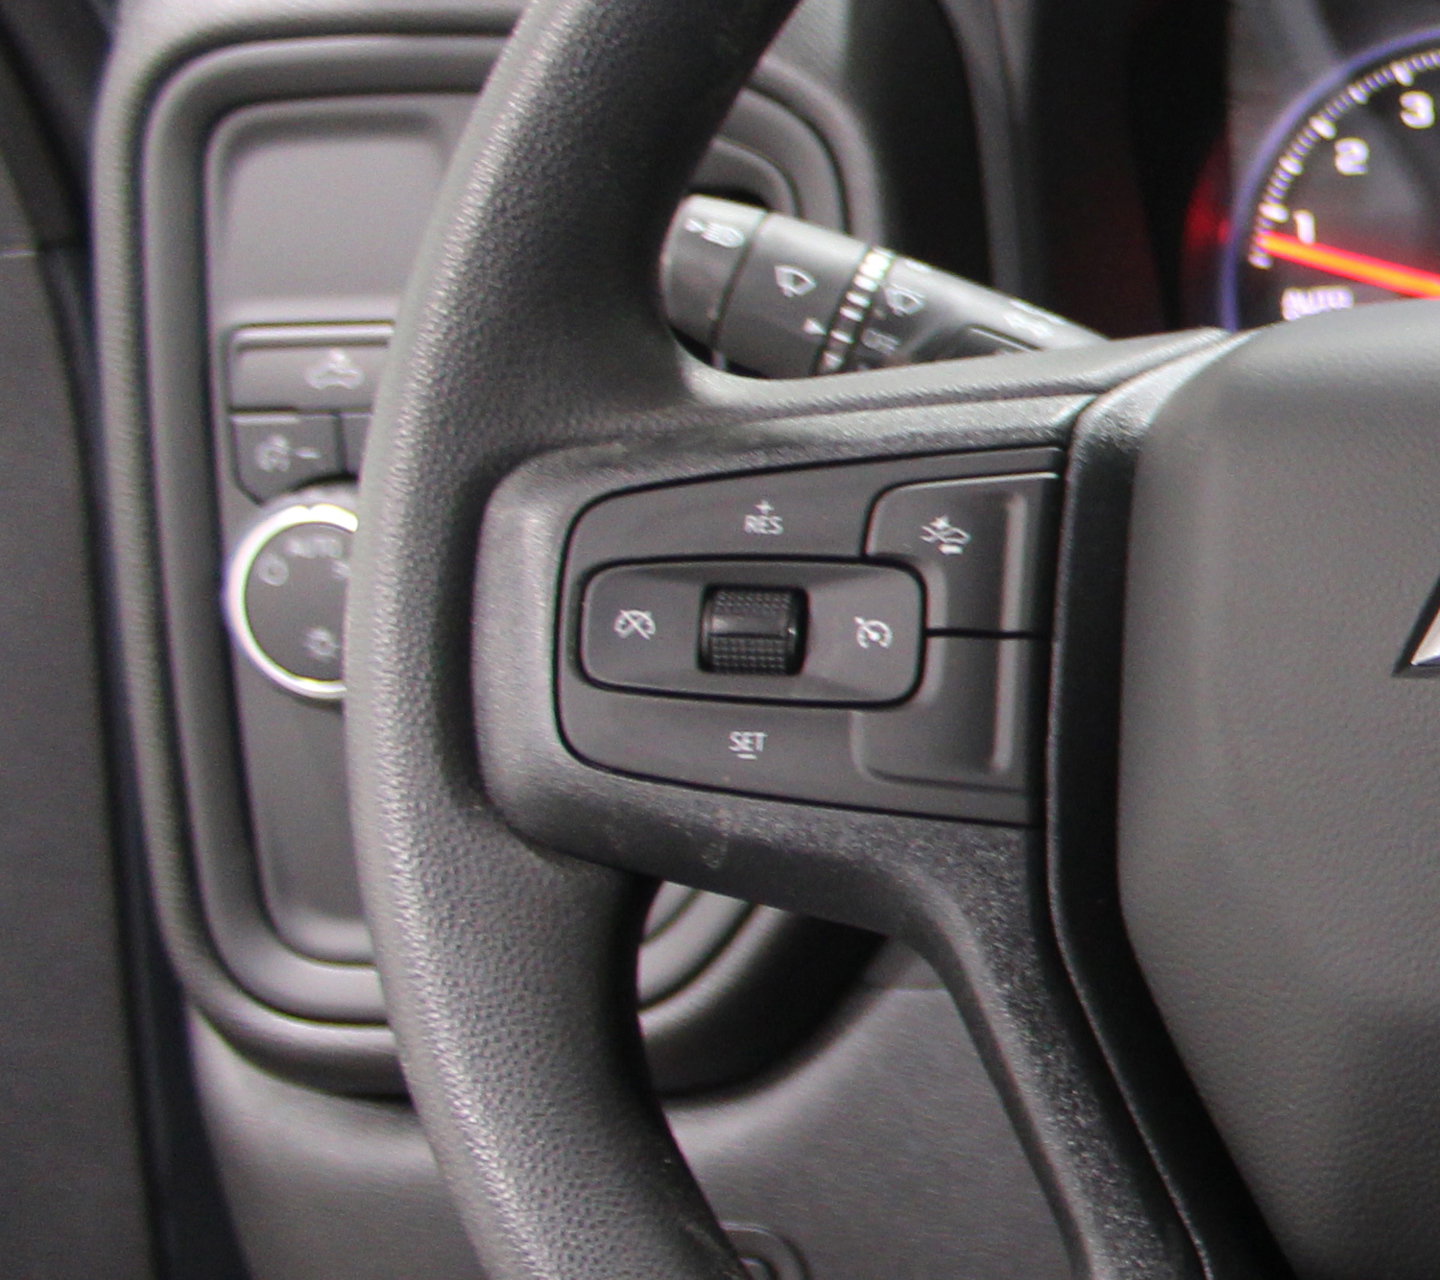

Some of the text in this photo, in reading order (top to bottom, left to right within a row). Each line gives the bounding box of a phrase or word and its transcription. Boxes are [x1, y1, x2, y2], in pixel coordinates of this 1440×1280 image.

[1400, 91, 1436, 129] 3
[1334, 137, 1370, 176] 2
[743, 514, 784, 535] RES
[728, 730, 768, 753] SET
